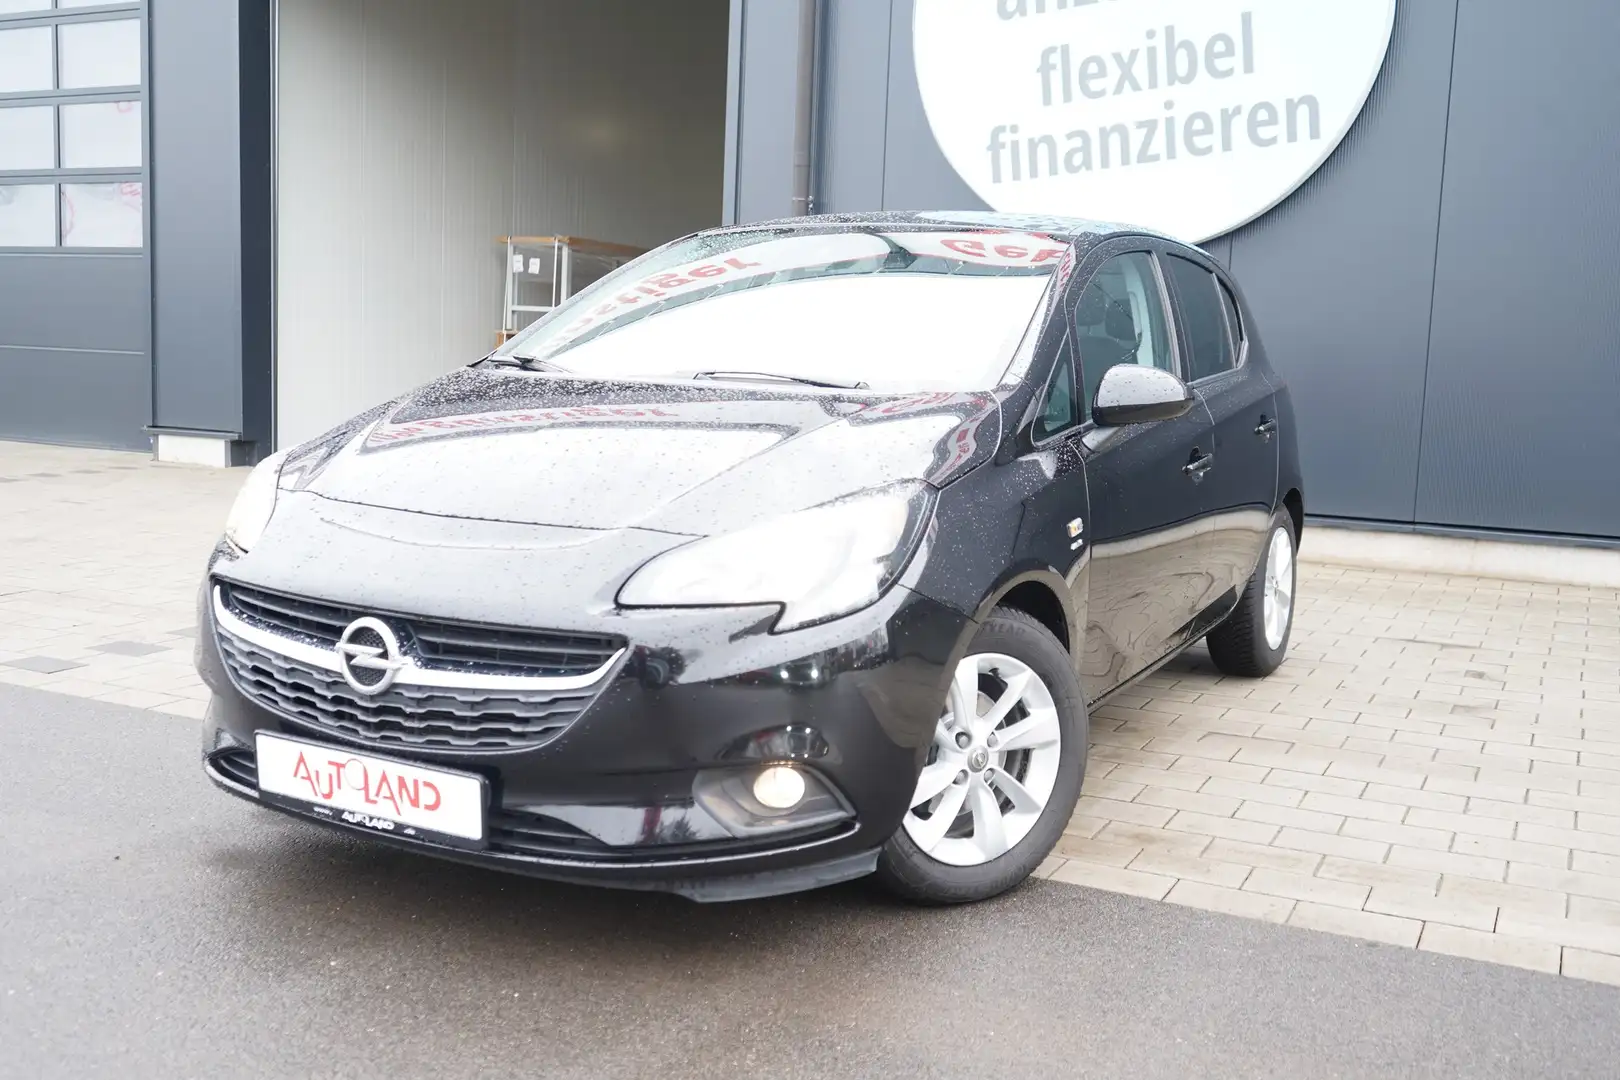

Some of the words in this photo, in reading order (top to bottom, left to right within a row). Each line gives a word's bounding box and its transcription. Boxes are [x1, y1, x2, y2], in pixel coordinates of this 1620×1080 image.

[1036, 11, 1255, 107] flexibel
[986, 92, 1321, 184] finanzieren
[293, 751, 441, 816] AUTOLAND
